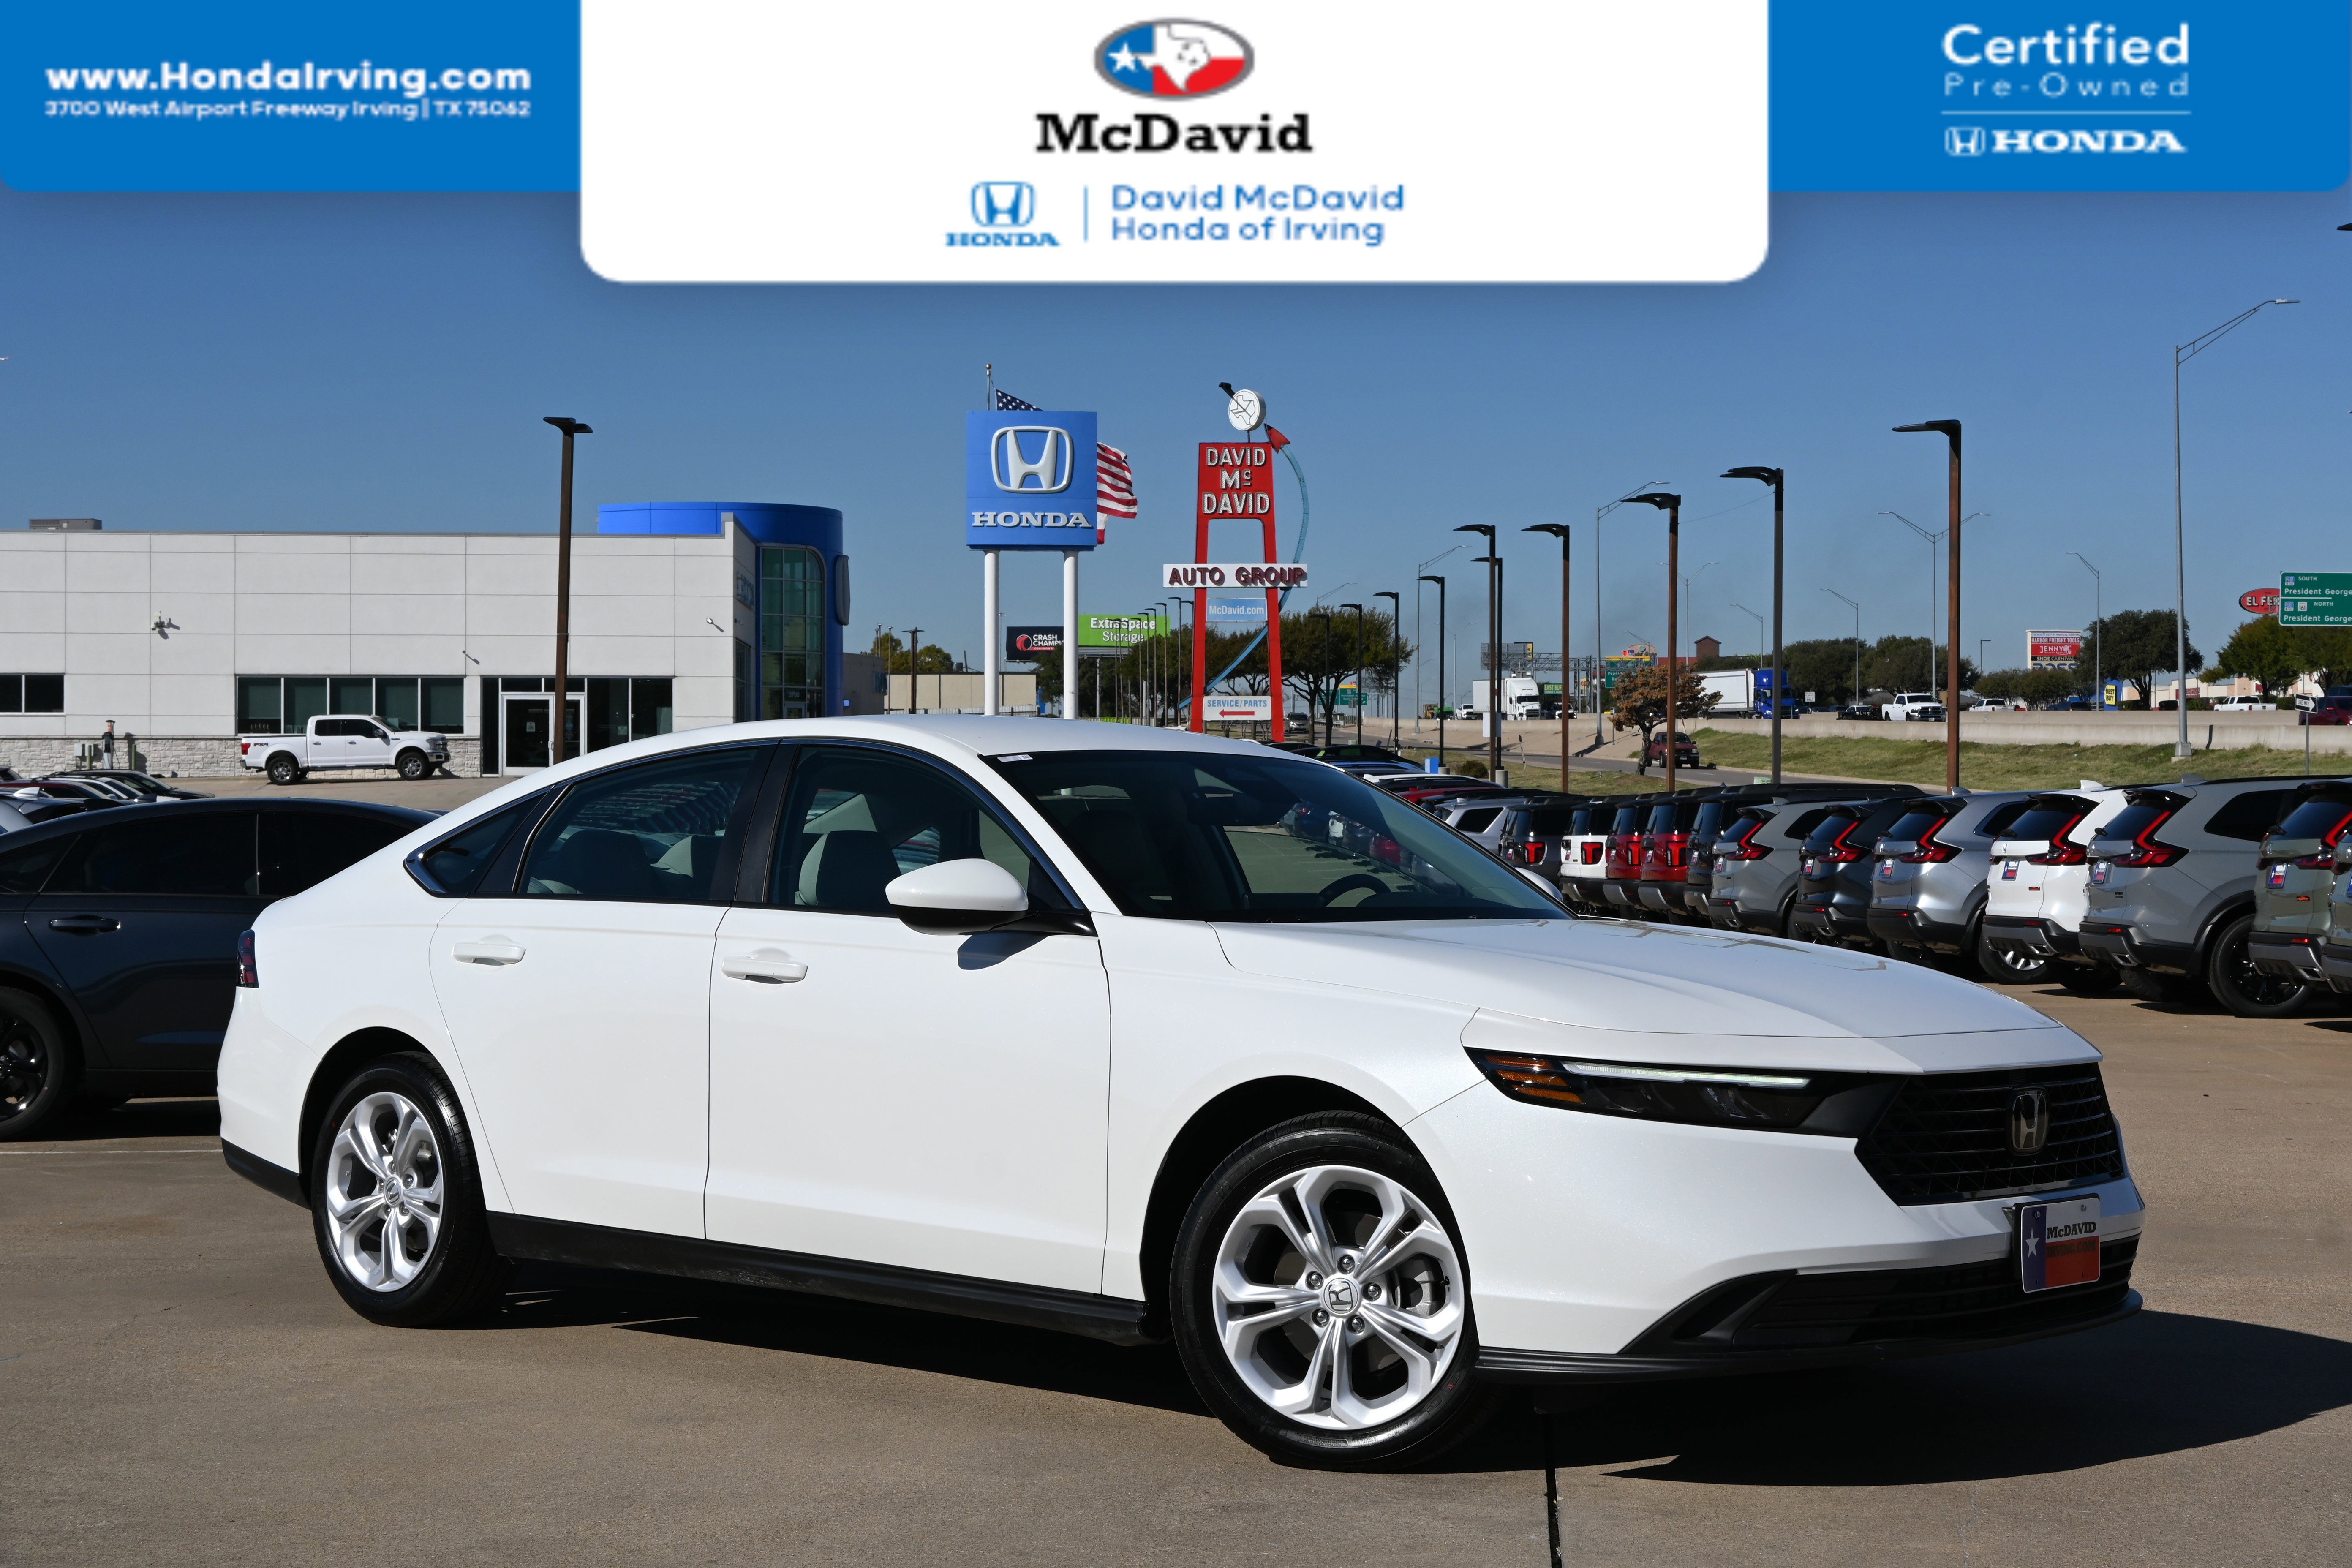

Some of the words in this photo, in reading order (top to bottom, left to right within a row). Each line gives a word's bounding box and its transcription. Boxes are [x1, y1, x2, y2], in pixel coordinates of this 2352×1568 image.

[1206, 447, 1266, 467] DAVID
[1202, 492, 1269, 514] DAVID
[972, 512, 1092, 528] HONDA
[1168, 567, 1224, 586] AUTO
[1235, 567, 1306, 586] GROUP
[2246, 596, 2259, 606] EL
[1209, 605, 1264, 615] McDavid.com
[1102, 631, 1144, 643] Storage
[2047, 1221, 2096, 1239] McDAVID
